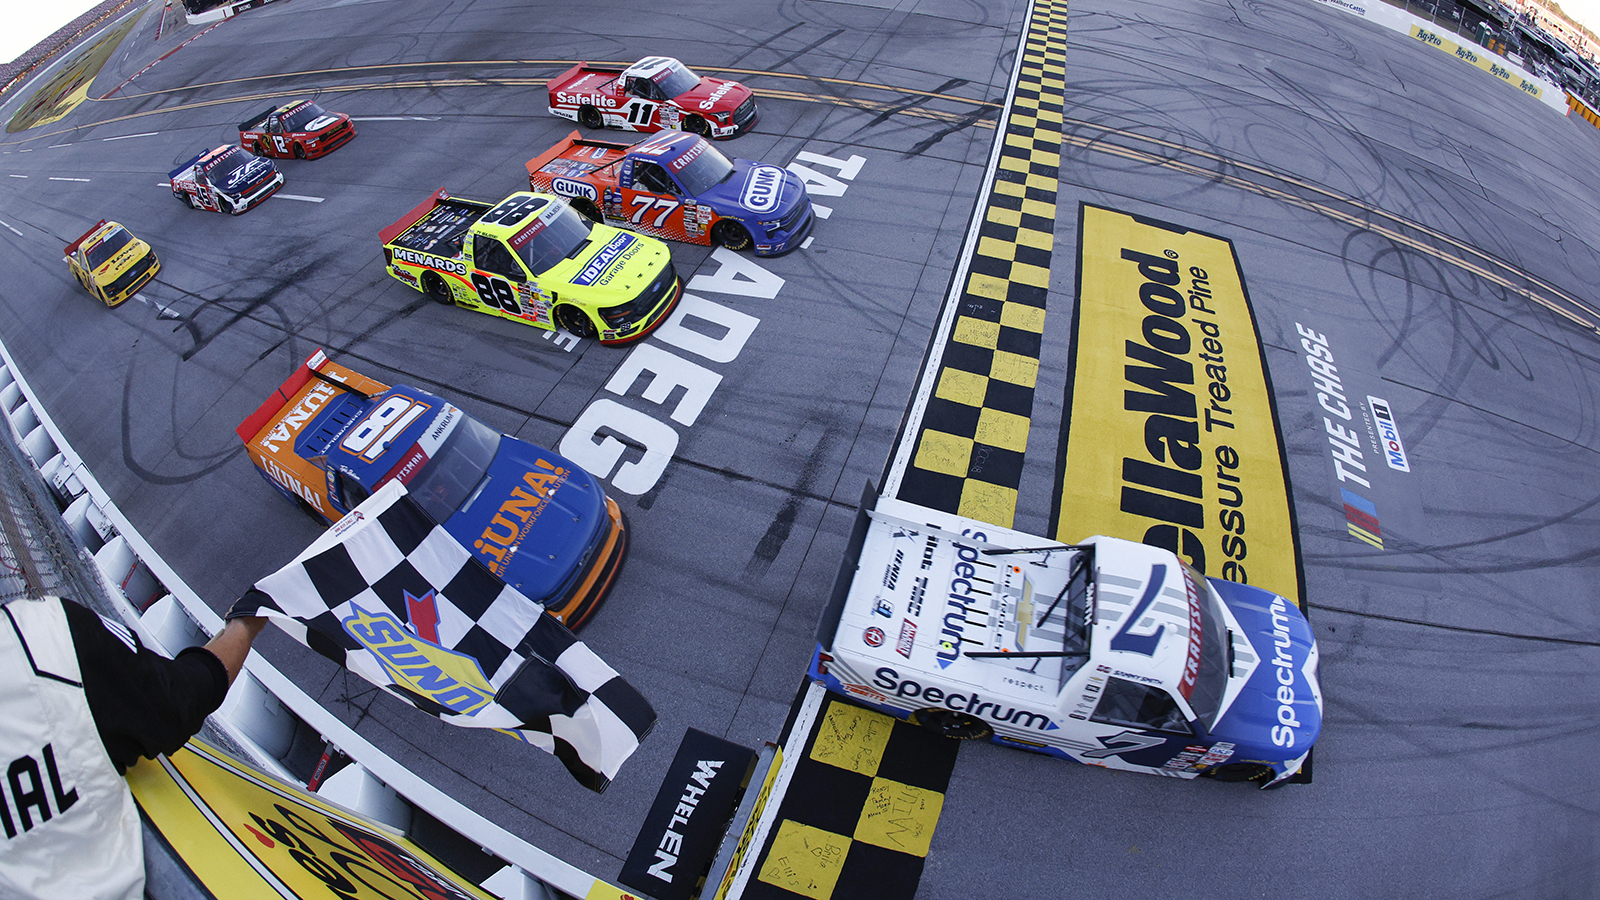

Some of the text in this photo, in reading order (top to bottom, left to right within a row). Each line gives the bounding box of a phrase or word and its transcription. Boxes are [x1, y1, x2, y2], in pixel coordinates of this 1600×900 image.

[556, 91, 617, 108] Safelite
[627, 102, 653, 124] 11
[205, 146, 241, 170] CRAFTSMAN
[272, 135, 288, 154] 12
[196, 187, 212, 207] 45
[555, 181, 593, 199] GUNK
[749, 168, 777, 207] GUNK
[480, 196, 550, 227] 88
[514, 221, 544, 245] CRAFTSMAN
[630, 194, 680, 229] 77
[393, 247, 467, 275] MENARDS
[580, 245, 618, 284] IDEAL
[599, 242, 645, 287] Garage Doors
[470, 271, 522, 316] 88
[619, 321, 632, 333] 88
[1188, 266, 1248, 584] essure Treated Pine
[1294, 321, 1371, 490] THE CHASE
[319, 406, 364, 455] CHEVROLET
[340, 394, 431, 463] 18
[395, 413, 455, 482] FTSMAN ANKRUM
[1359, 401, 1380, 455] PRESENTED BY
[1378, 420, 1406, 468] Mobil
[259, 455, 325, 513] LiUNA!
[518, 499, 550, 542] WORKFORCE
[887, 549, 905, 591] RENDA
[907, 576, 929, 617] TMC
[936, 528, 988, 662] Spectrum
[1109, 563, 1168, 658] 7
[1181, 563, 1202, 688] CRAFTSMAN
[1269, 603, 1301, 749] Spectrum
[872, 667, 1052, 731] Spectrum
[1081, 731, 1168, 760] 7
[646, 759, 726, 884] WHELEN
